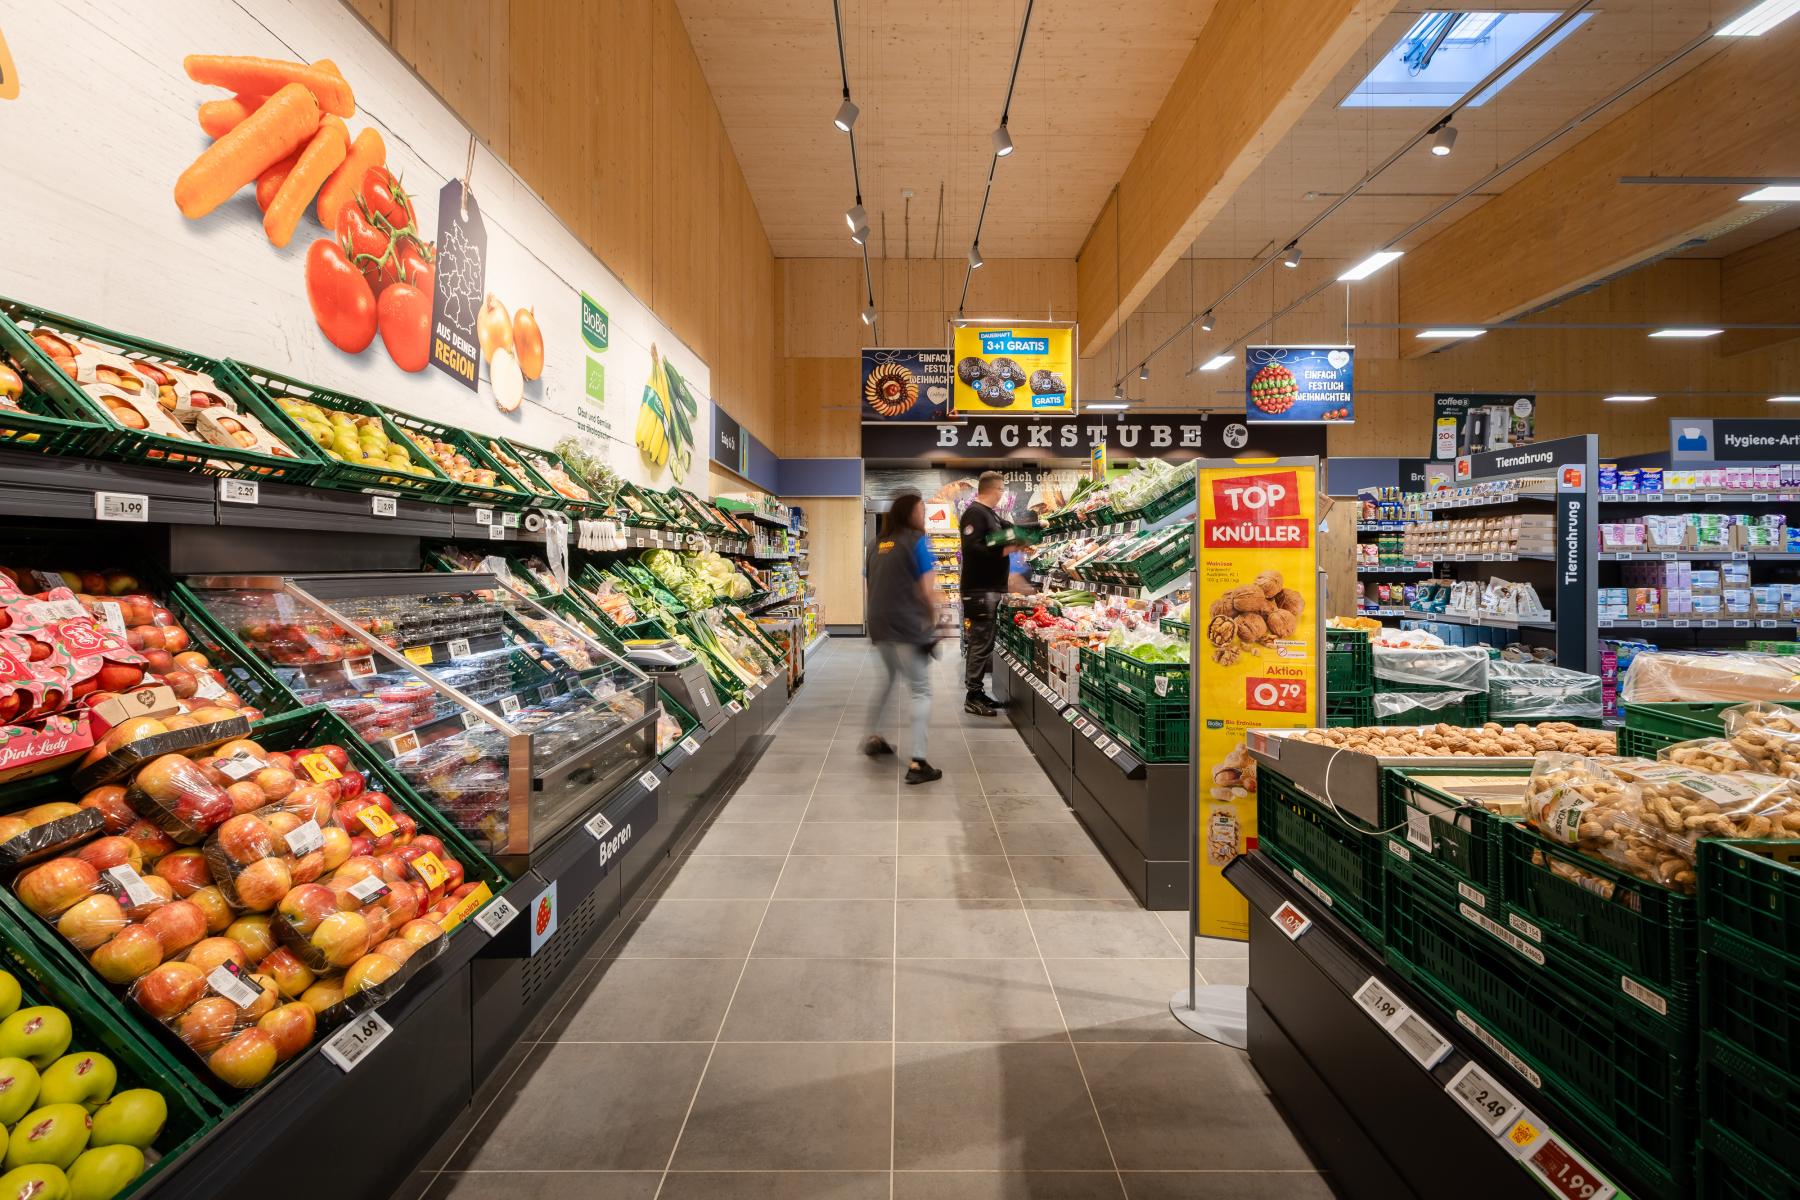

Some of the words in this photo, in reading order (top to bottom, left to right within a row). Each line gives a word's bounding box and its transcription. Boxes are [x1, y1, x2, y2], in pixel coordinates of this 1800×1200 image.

[583, 303, 607, 338] BioBio
[436, 322, 451, 341] AUS
[452, 333, 477, 360] DEINER
[980, 331, 1010, 339] DAUERHAFT
[987, 341, 1005, 350] 3+1
[1006, 341, 1045, 351] GRATIS
[435, 338, 475, 381] REGION
[919, 353, 951, 363] EINFACH
[1304, 370, 1337, 379] EINFACH
[1308, 381, 1344, 390] FESTLICH
[1034, 396, 1061, 405] GRATIS
[1296, 392, 1351, 401] WEIHNACHTEN
[936, 425, 1202, 448] BACKSTUBE
[1496, 451, 1554, 469] Tiernahrung
[237, 486, 254, 496] 2.29
[1224, 484, 1286, 511] TOP
[120, 501, 142, 513] 1.99
[1212, 522, 1301, 542] KNÜLLER
[1565, 501, 1581, 585] Tiernahrung
[1266, 666, 1303, 676] Aktion
[1254, 683, 1301, 707] 0.79
[0, 742, 36, 767] Pink
[36, 737, 69, 756] Lady
[599, 823, 632, 867] Beeren
[1374, 996, 1396, 1017] 1.99
[352, 1020, 378, 1044] 1.69
[1475, 1090, 1506, 1118] 2.49
[1557, 1163, 1596, 1199] 1.99
